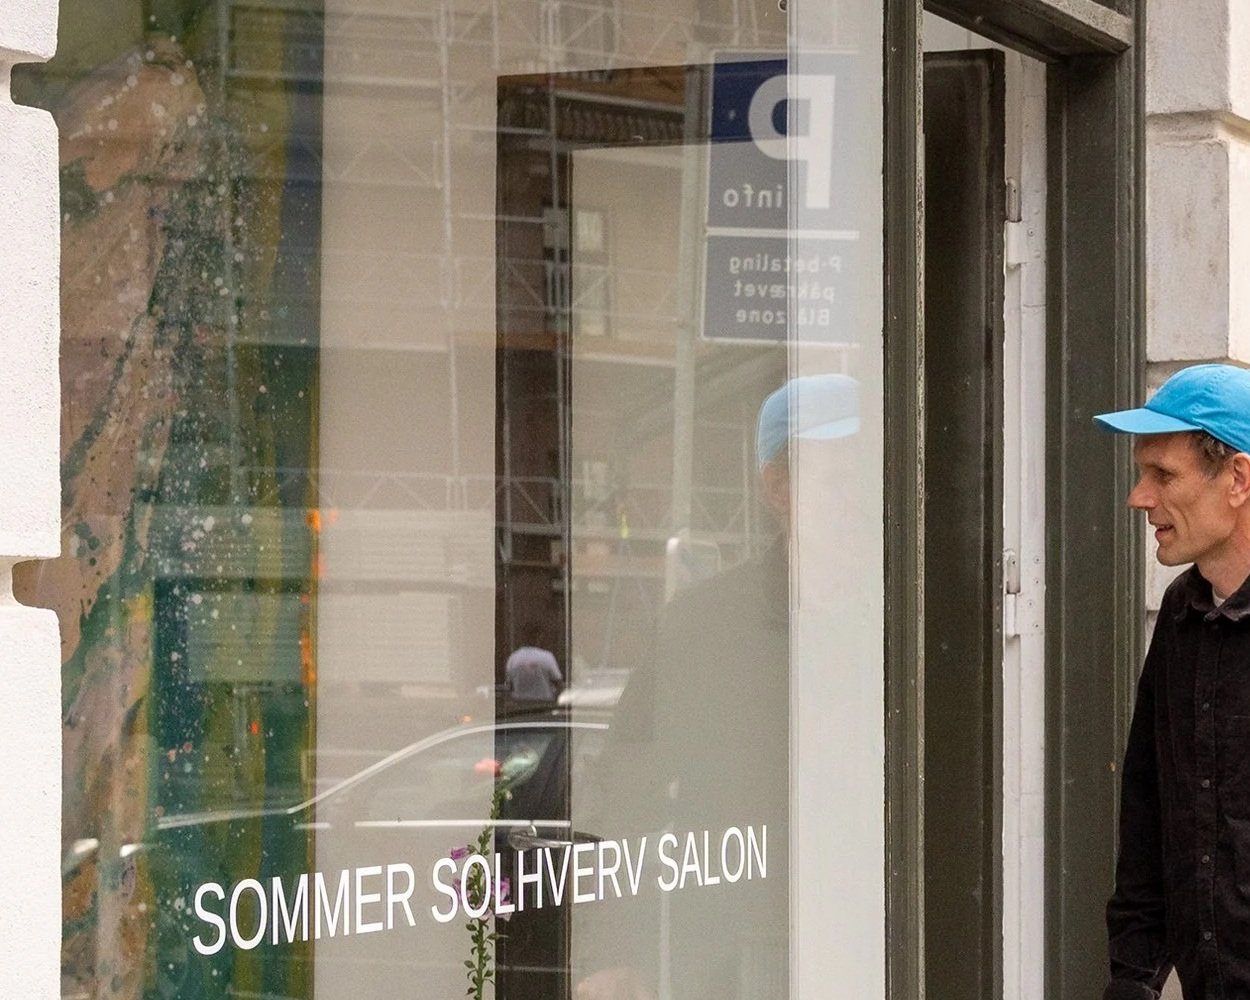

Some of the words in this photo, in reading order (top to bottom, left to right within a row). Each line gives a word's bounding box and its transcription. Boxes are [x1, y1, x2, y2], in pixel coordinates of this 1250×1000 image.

[192, 862, 416, 956] SOMMER
[431, 836, 647, 923] SOLHVERV
[657, 825, 768, 892] SALON
